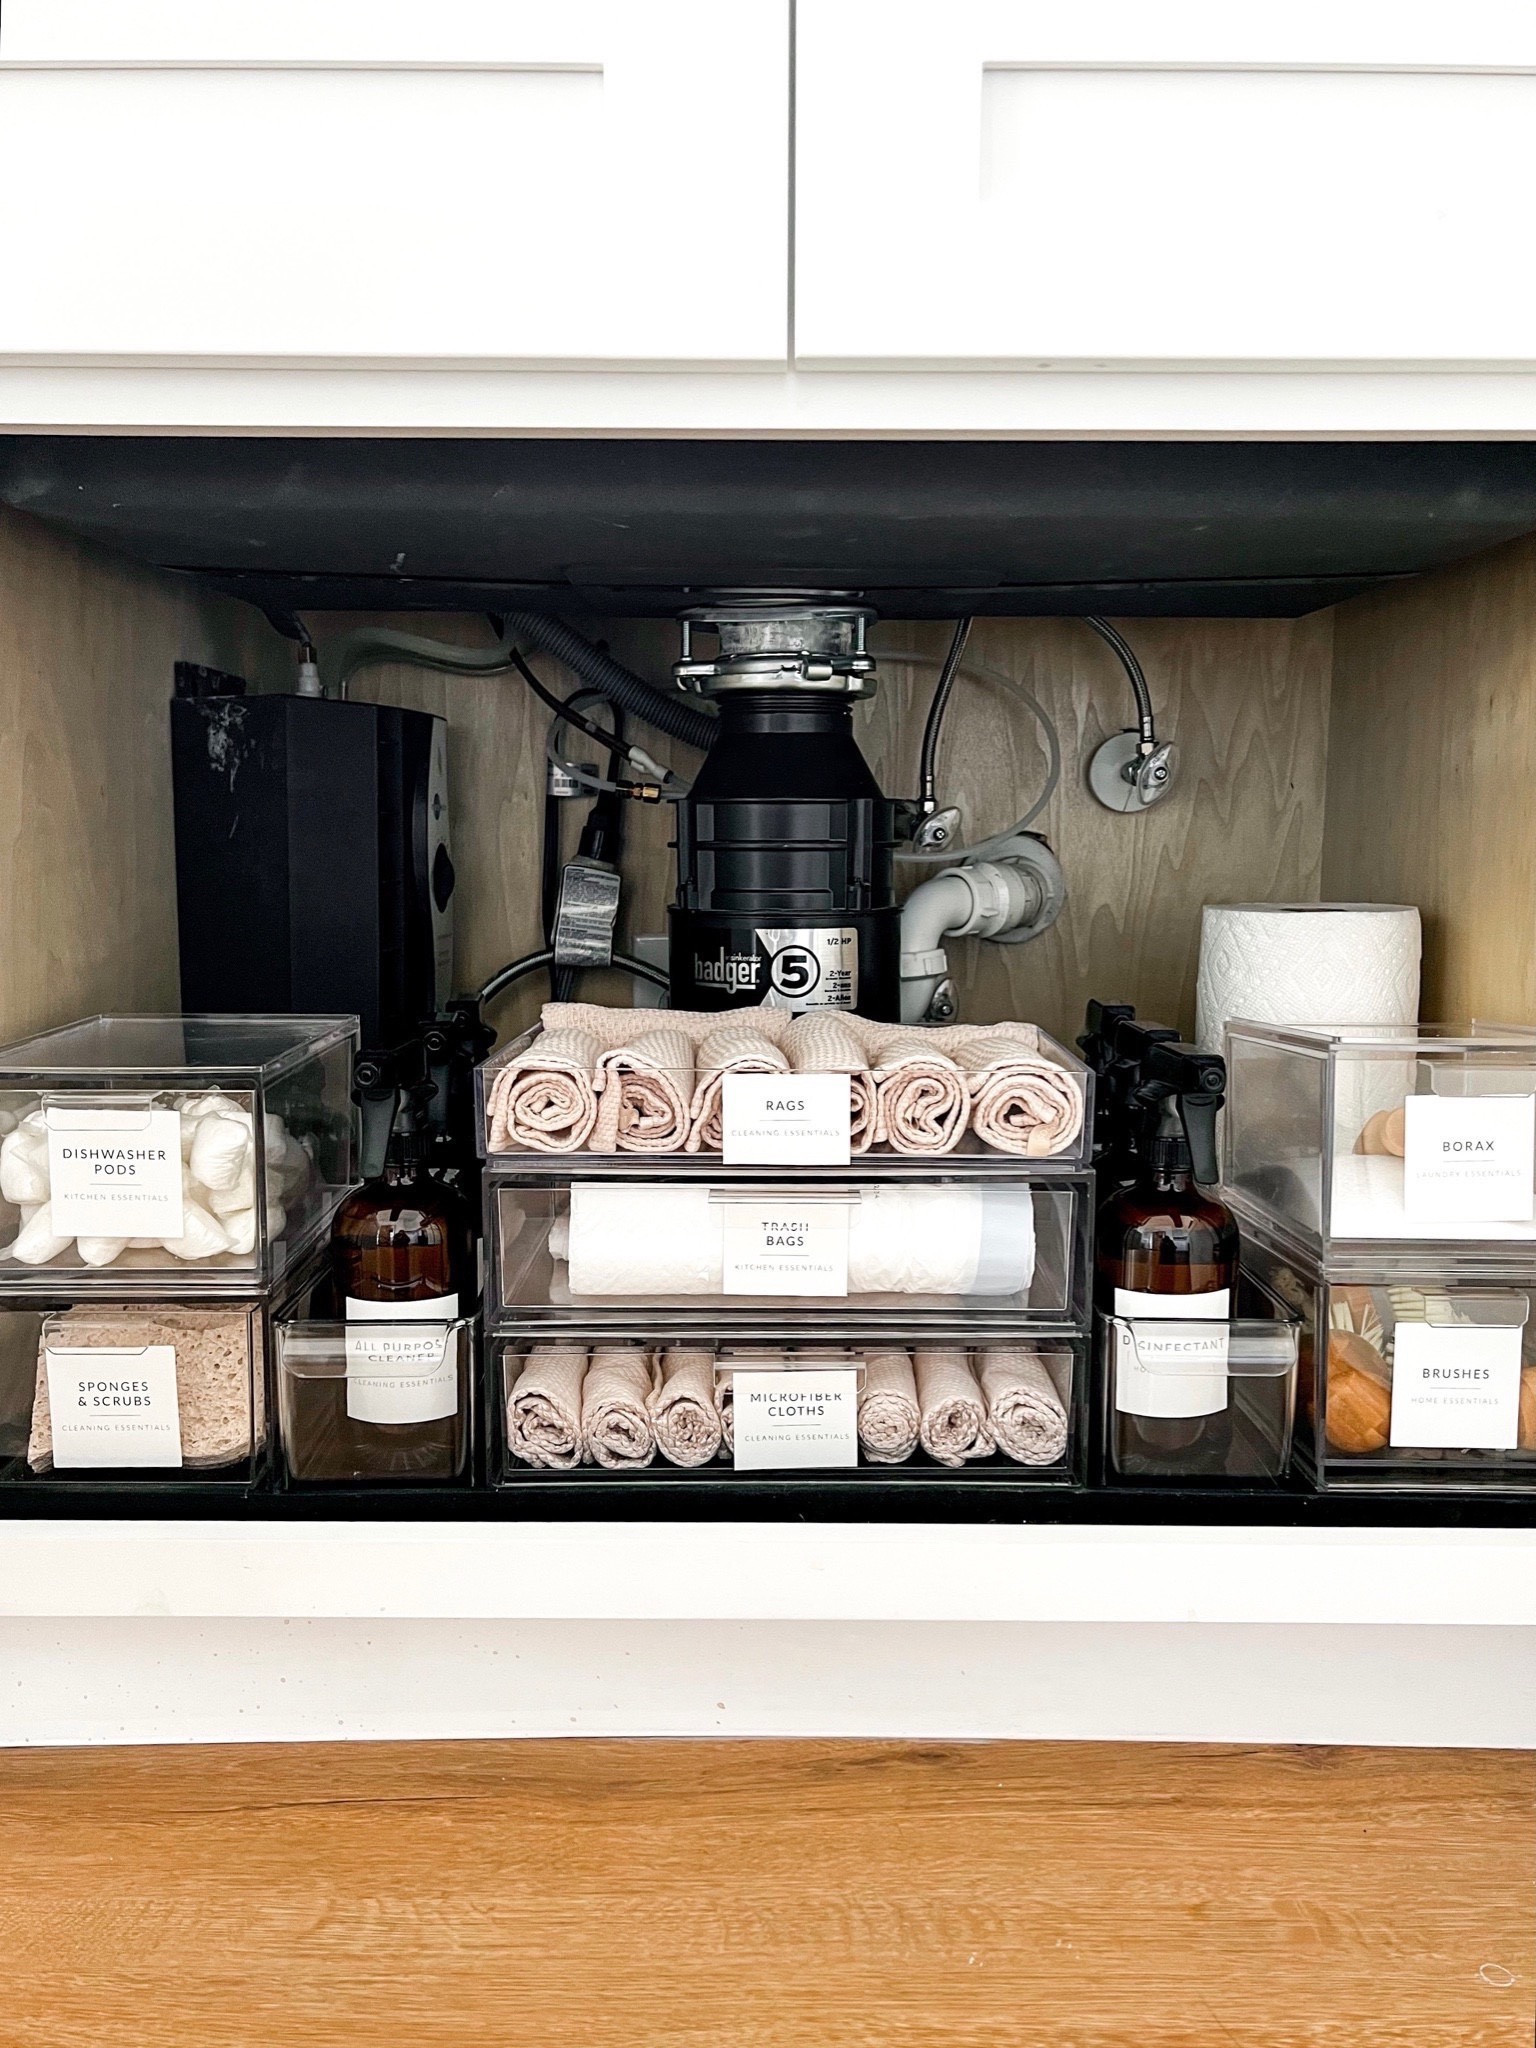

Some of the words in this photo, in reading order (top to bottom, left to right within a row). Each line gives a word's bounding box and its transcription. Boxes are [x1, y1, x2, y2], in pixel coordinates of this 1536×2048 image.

[826, 938, 839, 946] 1/2
[841, 937, 852, 945] HP
[780, 955, 809, 989] 5
[766, 1100, 805, 1111] RAGS
[731, 1128, 780, 1137] CLEANING
[784, 1128, 840, 1137] ESSENTIALS
[1442, 1140, 1495, 1152] BORAX
[62, 1148, 167, 1161] DISHWASHER
[94, 1164, 137, 1175] PODS
[1465, 1169, 1521, 1178] ESSENTIALS
[64, 1193, 107, 1201] KITCHEN
[111, 1194, 169, 1202] ESSENTIALS
[766, 1235, 804, 1247] BAGS
[779, 1264, 834, 1272] ESSENTIALS
[355, 1340, 377, 1351] ALL
[1122, 1335, 1225, 1351] DSINFECTANT
[1422, 1368, 1490, 1380] BRUSHES
[78, 1381, 149, 1392] SPONGES
[400, 1375, 453, 1388] ESSENTIALS
[78, 1396, 88, 1407] &
[93, 1396, 152, 1407] SCRUBS
[750, 1392, 842, 1403] MICROFIBER
[1443, 1397, 1499, 1405] ESSENTIALS
[768, 1405, 825, 1417] CLOTHS
[62, 1424, 110, 1432] CLEANING
[115, 1424, 171, 1432] ESSENTIALS
[744, 1434, 792, 1442] CLEANING
[795, 1433, 850, 1441] ESSENTIALS
